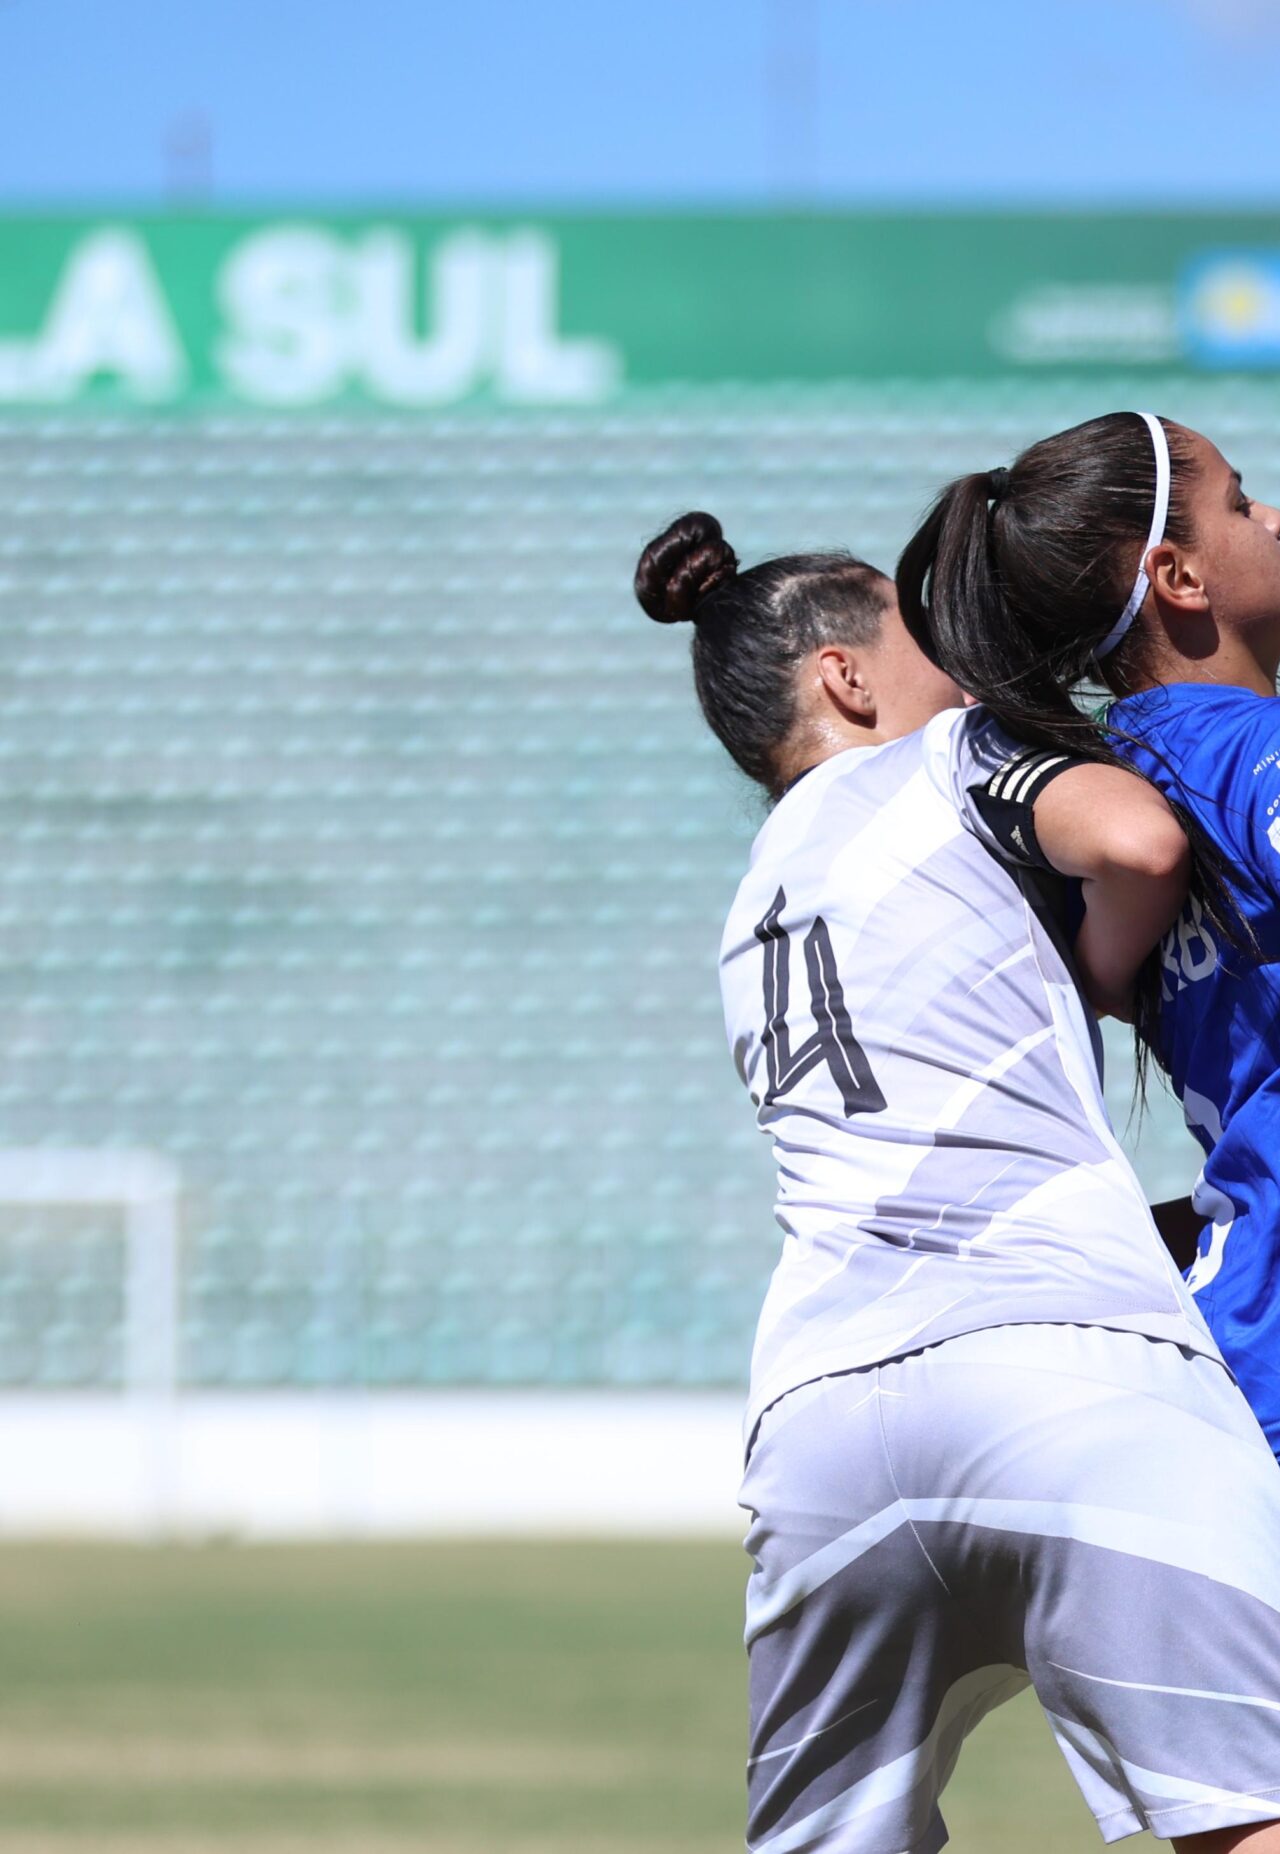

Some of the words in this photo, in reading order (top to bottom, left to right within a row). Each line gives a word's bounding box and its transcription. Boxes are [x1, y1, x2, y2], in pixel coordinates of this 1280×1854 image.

[0, 226, 188, 403] A
[214, 224, 622, 403] SUL
[754, 884, 888, 1119] 4
